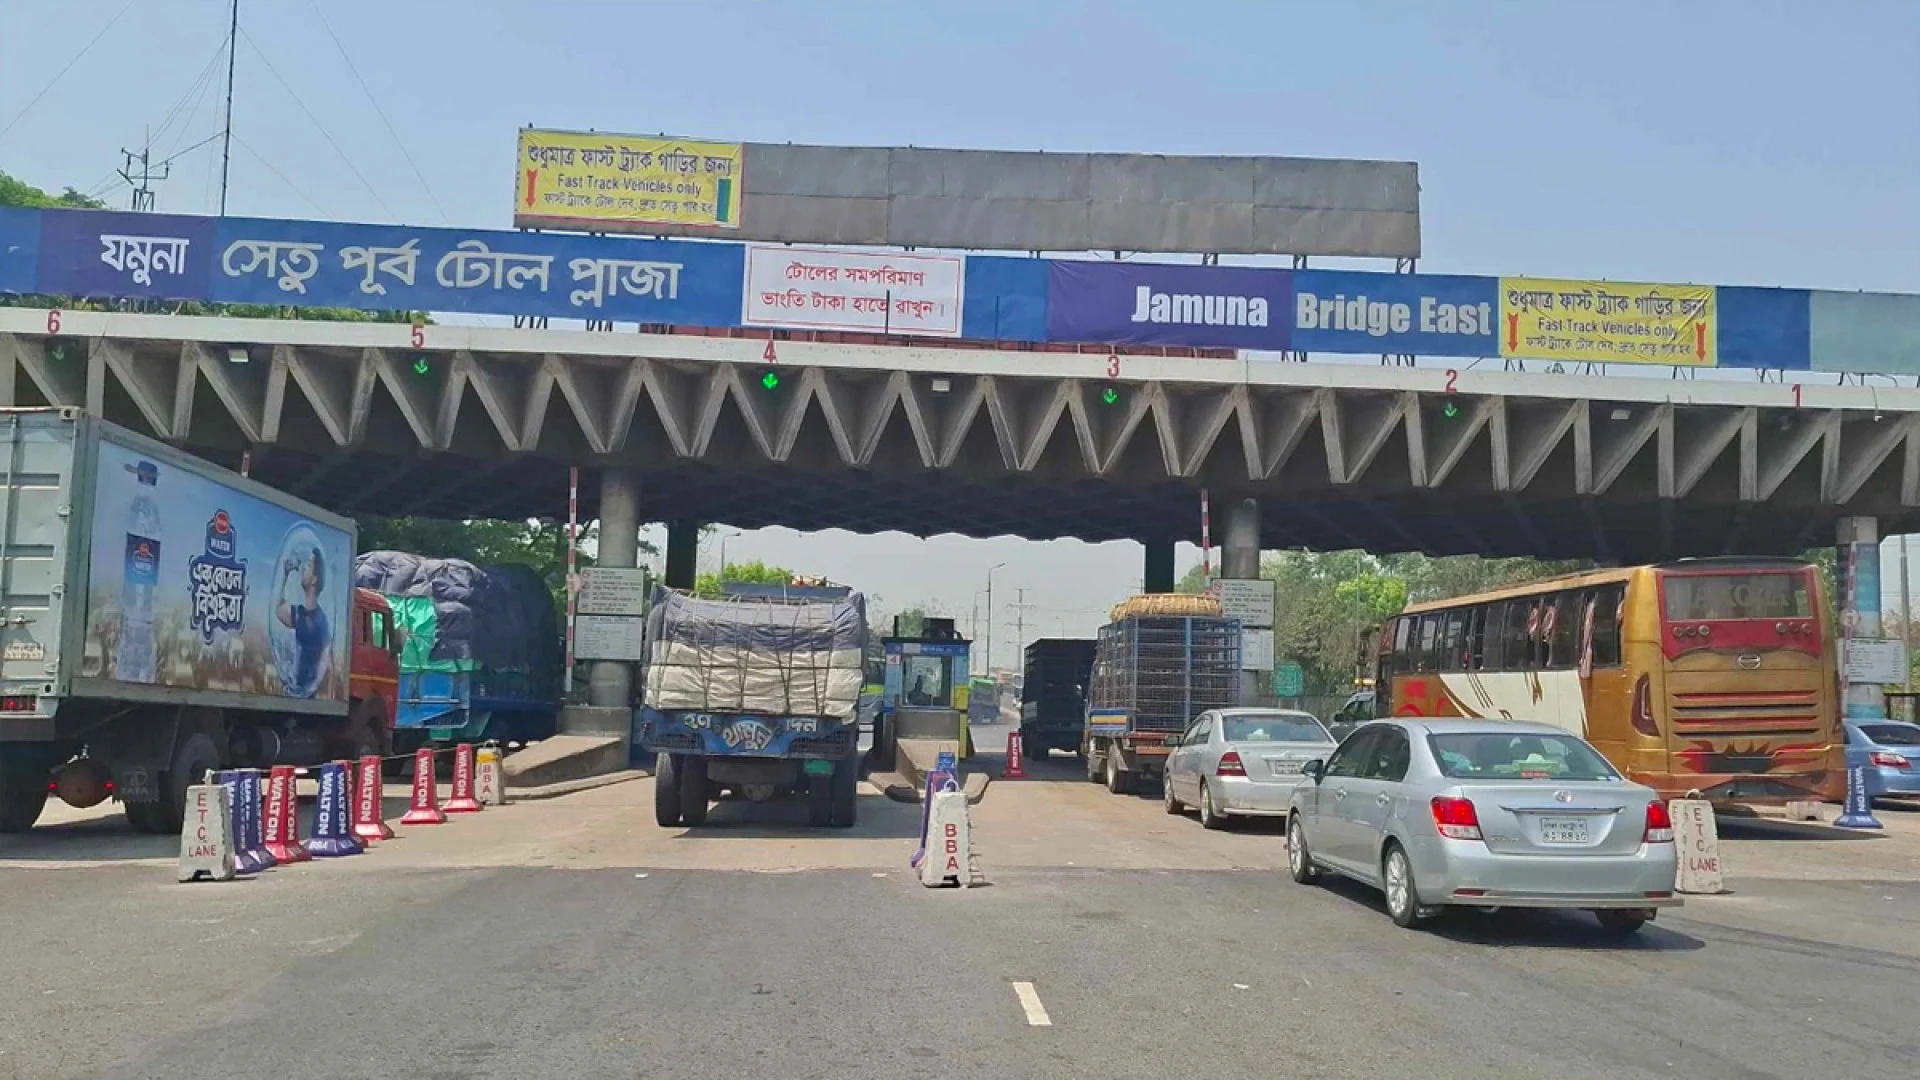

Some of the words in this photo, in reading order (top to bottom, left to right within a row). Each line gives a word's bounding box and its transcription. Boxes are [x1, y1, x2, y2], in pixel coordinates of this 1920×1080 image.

[528, 145, 575, 169] শুধুমাত্র
[581, 145, 616, 167] ফাস্ট
[658, 147, 699, 176] গাড়ির
[704, 156, 733, 177] জন্য
[558, 174, 583, 188] Fast
[588, 176, 618, 190] Track
[623, 178, 672, 193] Vehicles
[677, 182, 701, 198] only
[100, 234, 189, 286] যমুনা
[222, 239, 324, 295] সেতু
[338, 238, 421, 296] পূর্ব
[436, 240, 554, 292] টোল
[568, 257, 683, 308] প্লাজা
[785, 261, 838, 282] টোলের
[845, 265, 925, 287] সমপরিমাণ
[761, 288, 808, 310] ভাংতি
[812, 290, 846, 311] টাকা
[853, 297, 889, 312] হাতে
[1131, 286, 1268, 327] Jamuna
[1296, 293, 1410, 336] Bridge
[1420, 296, 1491, 335] East
[1507, 290, 1553, 314] শুধুমাত্র
[1560, 290, 1592, 311] ফাস্ট
[1635, 291, 1674, 320] গাড়ির
[47, 310, 61, 334] 6
[1538, 317, 1562, 331] Fast
[1567, 319, 1597, 333] Track
[412, 324, 424, 349] 5
[763, 340, 777, 364] 4
[1108, 355, 1119, 378] 3
[1446, 369, 1458, 395] 2
[1792, 384, 1801, 409] 1
[418, 757, 429, 807] WALTON
[457, 751, 467, 797] WALTON
[318, 772, 333, 835] WALTON
[360, 764, 375, 821] WALTON
[265, 776, 284, 841] WALTON
[1694, 808, 1705, 851] ETC
[188, 845, 216, 857] LANE
[945, 824, 958, 869] BBA
[1690, 858, 1718, 872] LANE
